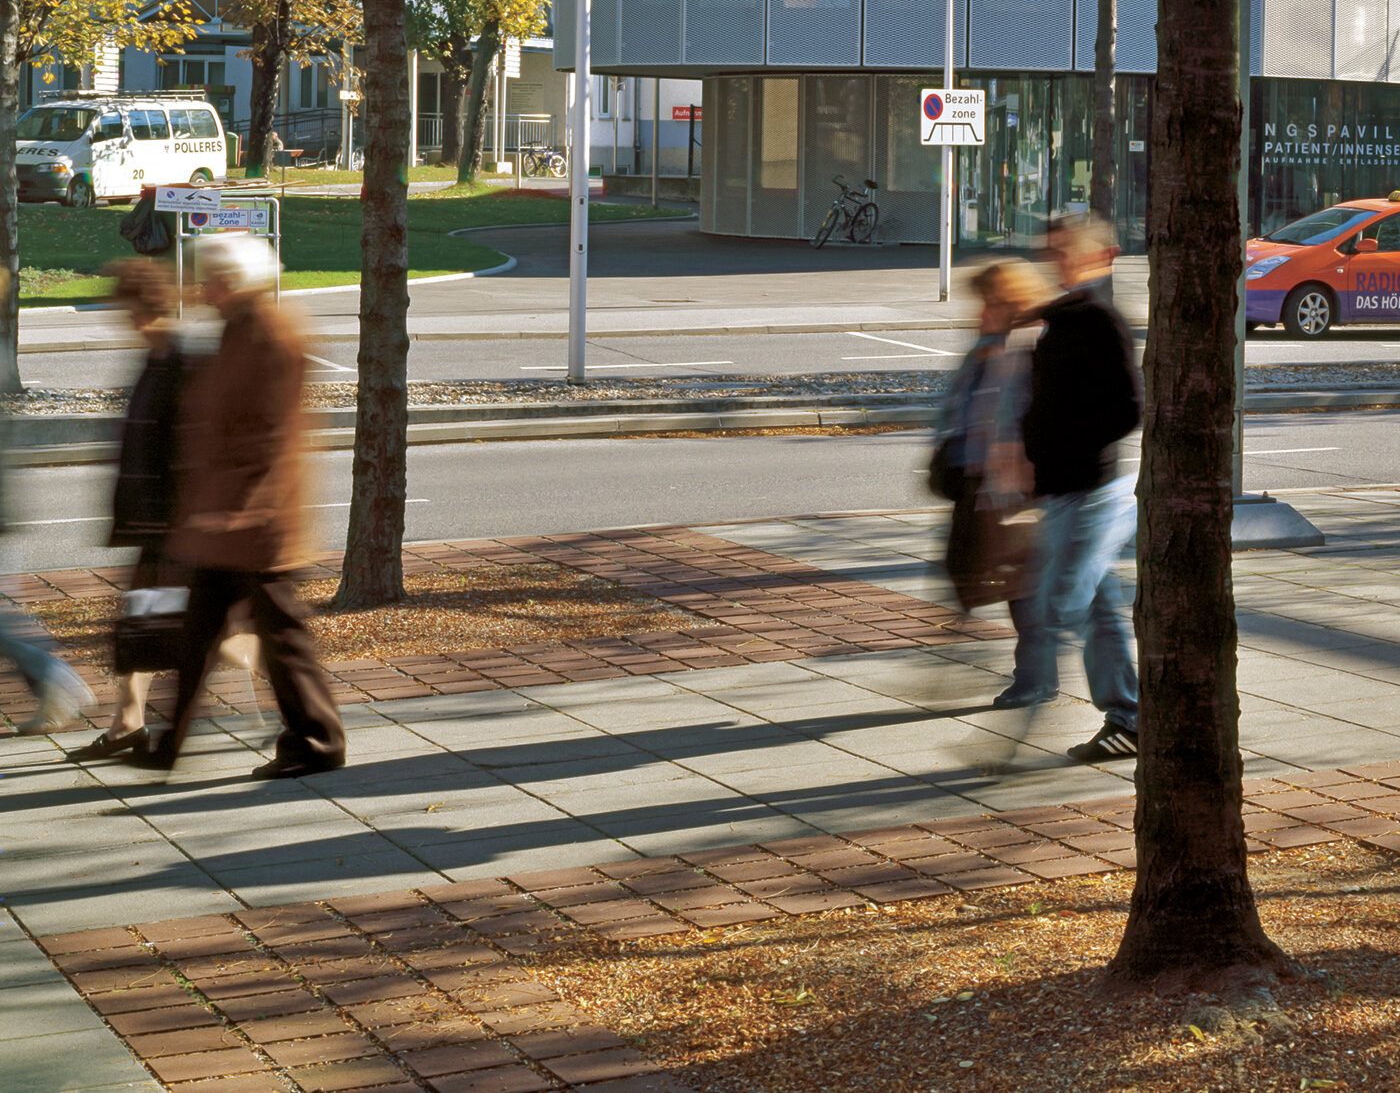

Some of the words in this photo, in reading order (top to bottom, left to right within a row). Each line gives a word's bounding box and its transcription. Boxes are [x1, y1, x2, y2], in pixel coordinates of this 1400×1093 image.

[945, 93, 983, 104] Bezahl-
[952, 110, 976, 119] zone
[174, 140, 223, 154] POLLERES
[132, 169, 145, 180] 20
[218, 218, 240, 226] Zone
[1356, 296, 1379, 309] DAS
